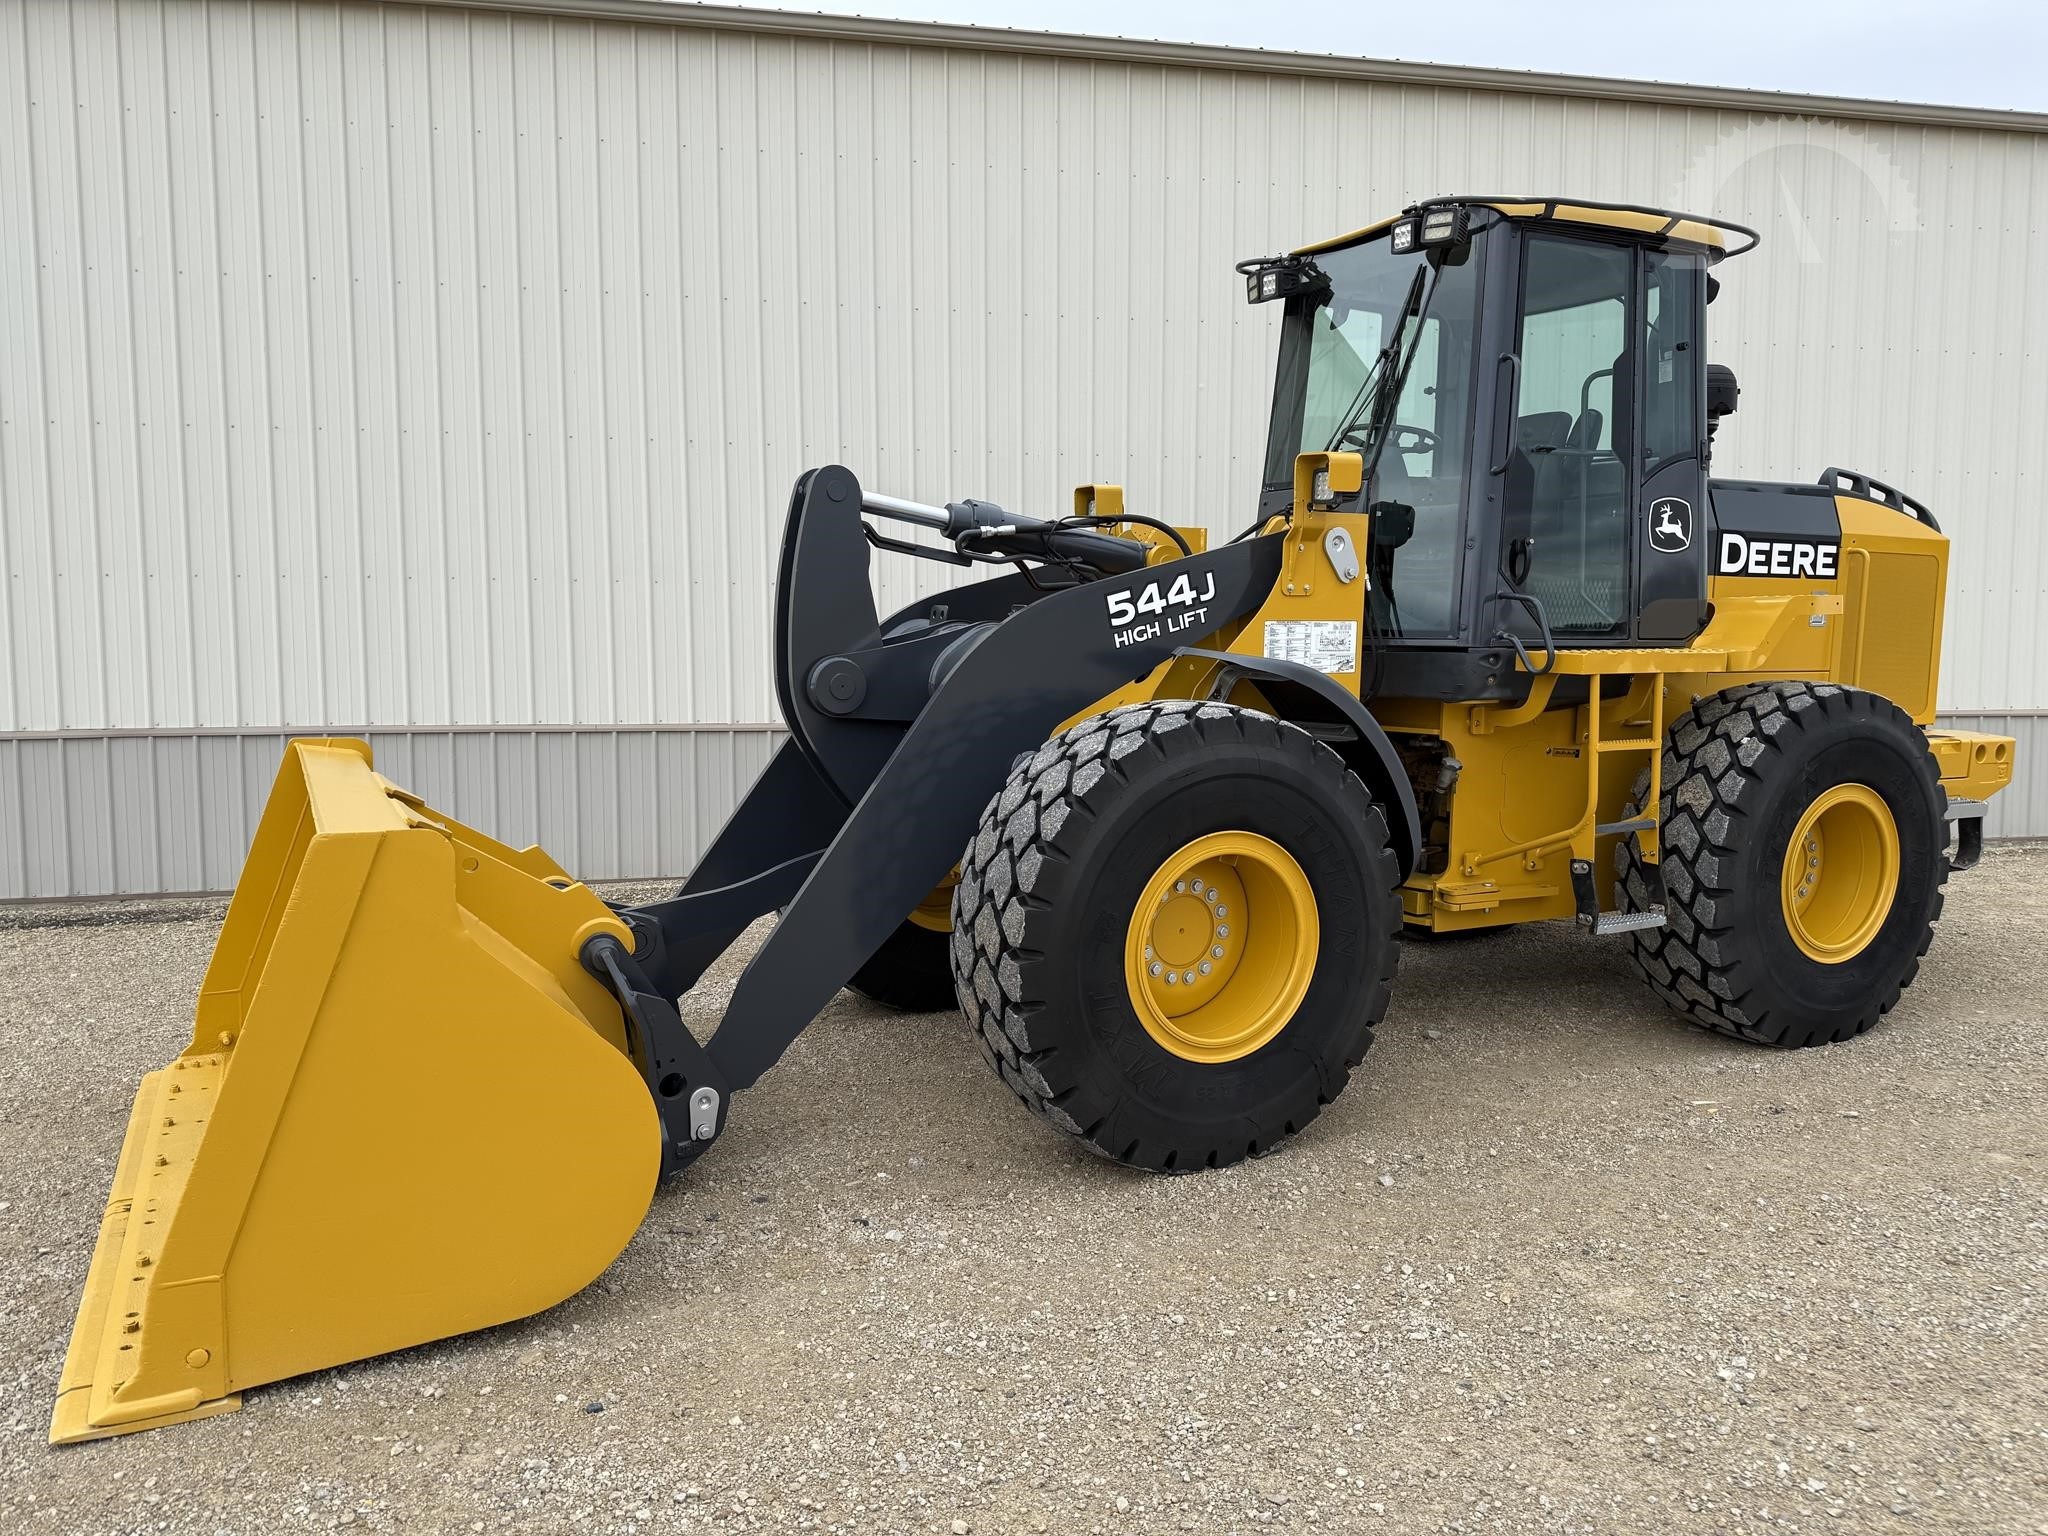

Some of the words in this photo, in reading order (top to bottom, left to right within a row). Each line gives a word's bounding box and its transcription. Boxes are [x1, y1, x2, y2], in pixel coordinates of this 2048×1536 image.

[1720, 533, 1837, 576] DEERE
[1106, 571, 1216, 627] 544J
[1113, 622, 1161, 649] HIGH
[1167, 607, 1208, 632] LIFT
[1295, 816, 1357, 959] TITAN
